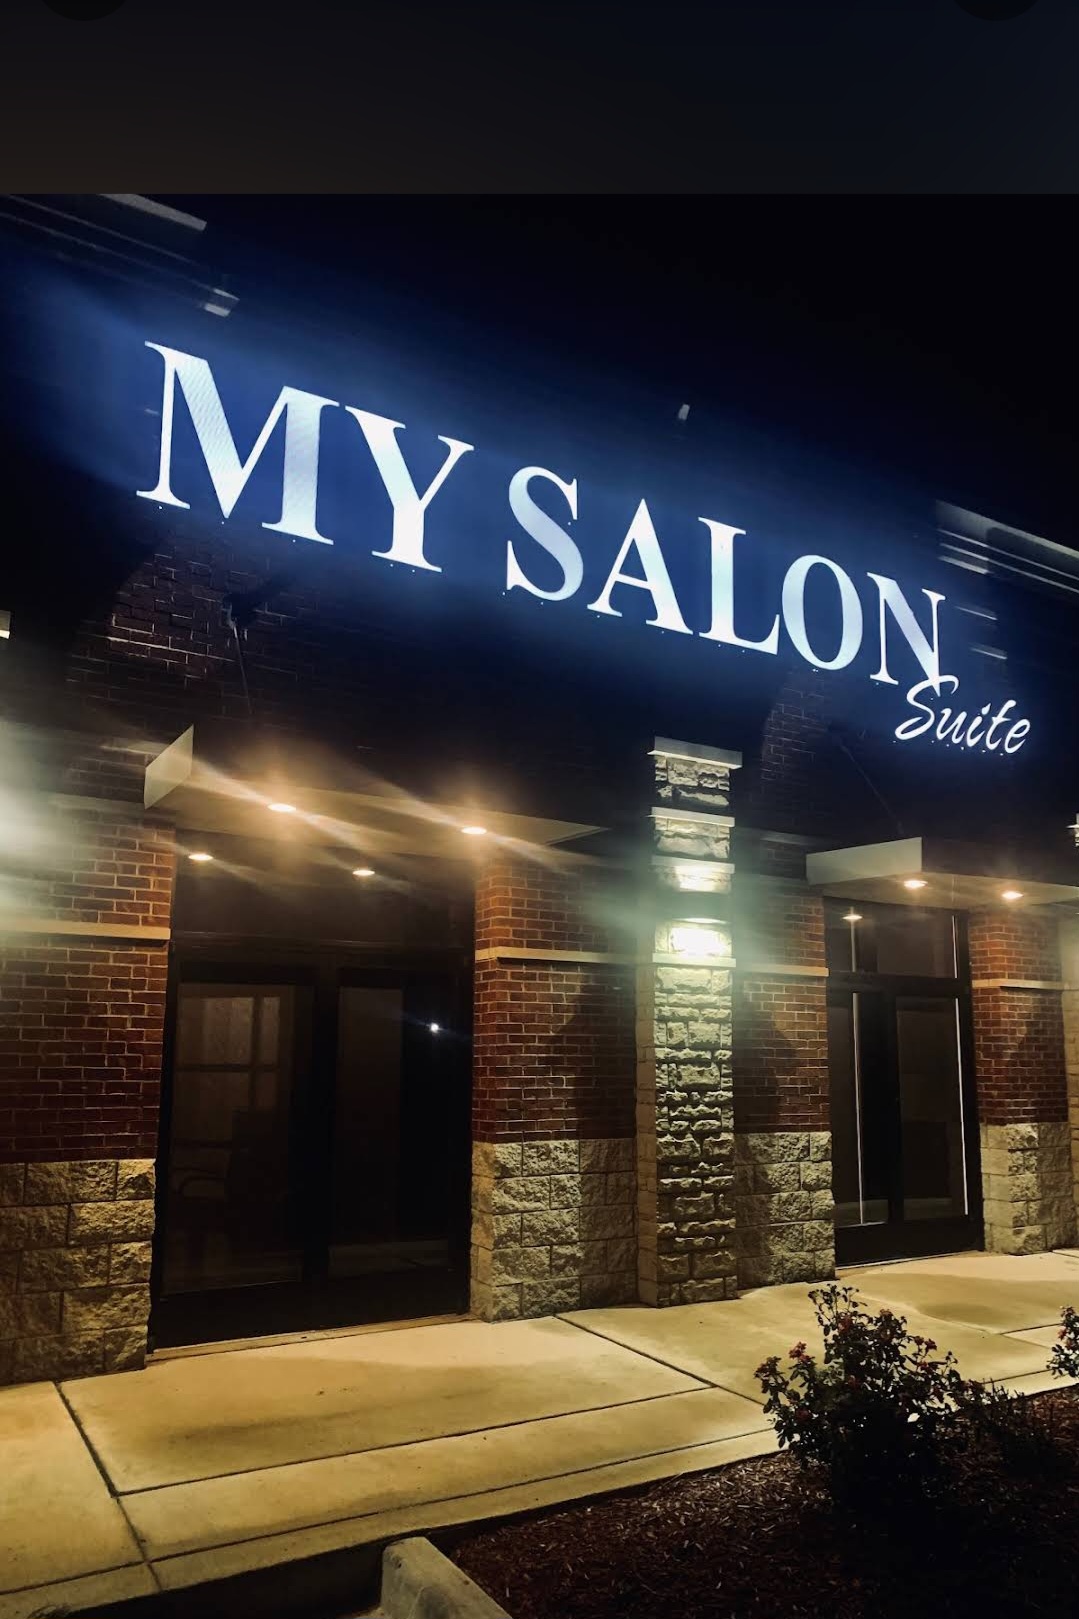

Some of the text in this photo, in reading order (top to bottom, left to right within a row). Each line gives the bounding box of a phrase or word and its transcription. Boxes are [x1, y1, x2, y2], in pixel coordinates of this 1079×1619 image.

[137, 341, 946, 695] MY SALON
[894, 675, 1031, 754] Suite
